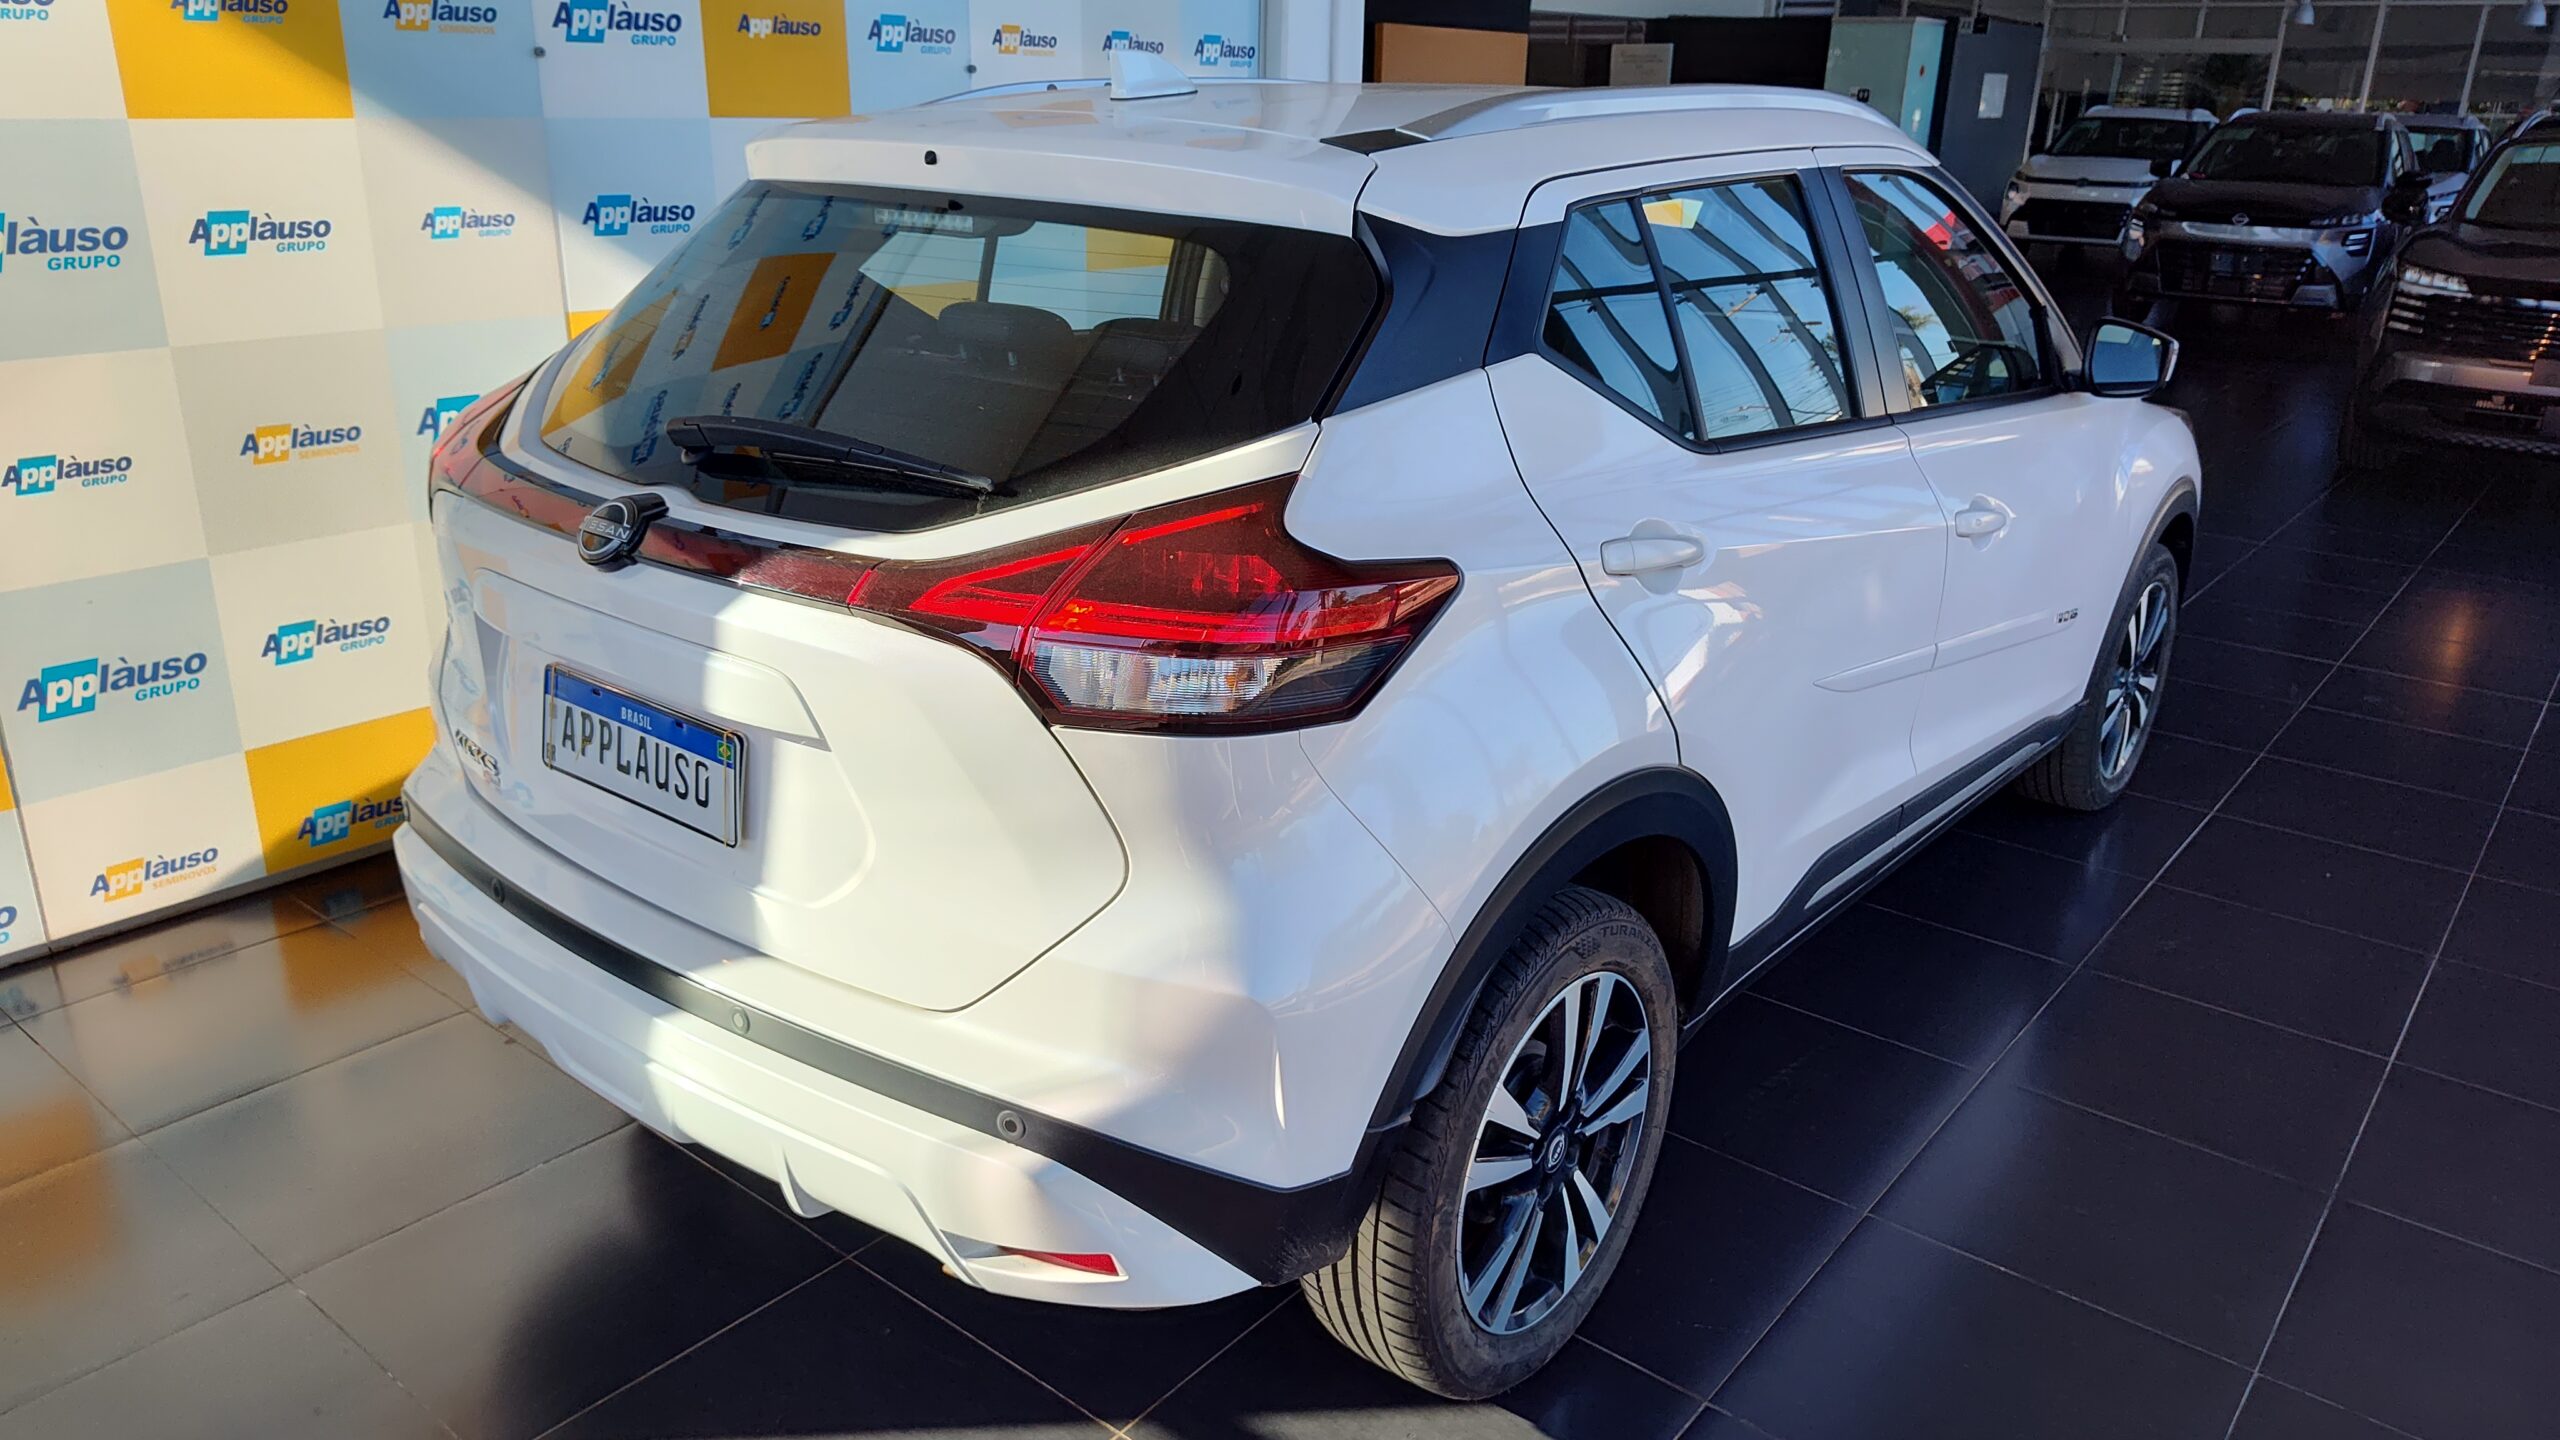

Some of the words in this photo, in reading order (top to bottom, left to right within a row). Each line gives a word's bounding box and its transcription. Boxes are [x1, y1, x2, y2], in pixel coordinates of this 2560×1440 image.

[0, 8, 49, 20] RUPO
[553, 1, 682, 37] Applàuso
[737, 13, 822, 38] Applàuso
[631, 34, 677, 46] GRUPO
[868, 18, 956, 47] Applàuso
[993, 28, 1057, 50] Applàuso
[1194, 39, 1256, 62] Applàuso
[421, 209, 516, 234] Applàuso
[583, 198, 695, 231] Applàuso
[0, 217, 129, 255] làuso
[189, 213, 332, 250] Applàuso
[478, 228, 512, 237] GRUPO
[651, 223, 691, 234] GRUPO
[276, 240, 326, 253] GRUPO
[47, 254, 121, 271] GRUPO
[240, 424, 362, 459] Applàuso
[1, 455, 133, 491] Applàuso
[81, 474, 128, 488] GRUPO
[261, 616, 391, 660] Applàuso
[340, 635, 385, 652] GRUPO
[17, 652, 208, 714] Applàuso
[135, 677, 200, 702] GRUPO
[620, 706, 652, 731] BRASIL
[562, 705, 709, 809] APPLAUSO
[298, 797, 404, 841] Applàus
[90, 848, 219, 897] Applàuso
[153, 865, 218, 889] SEMINOVOS
